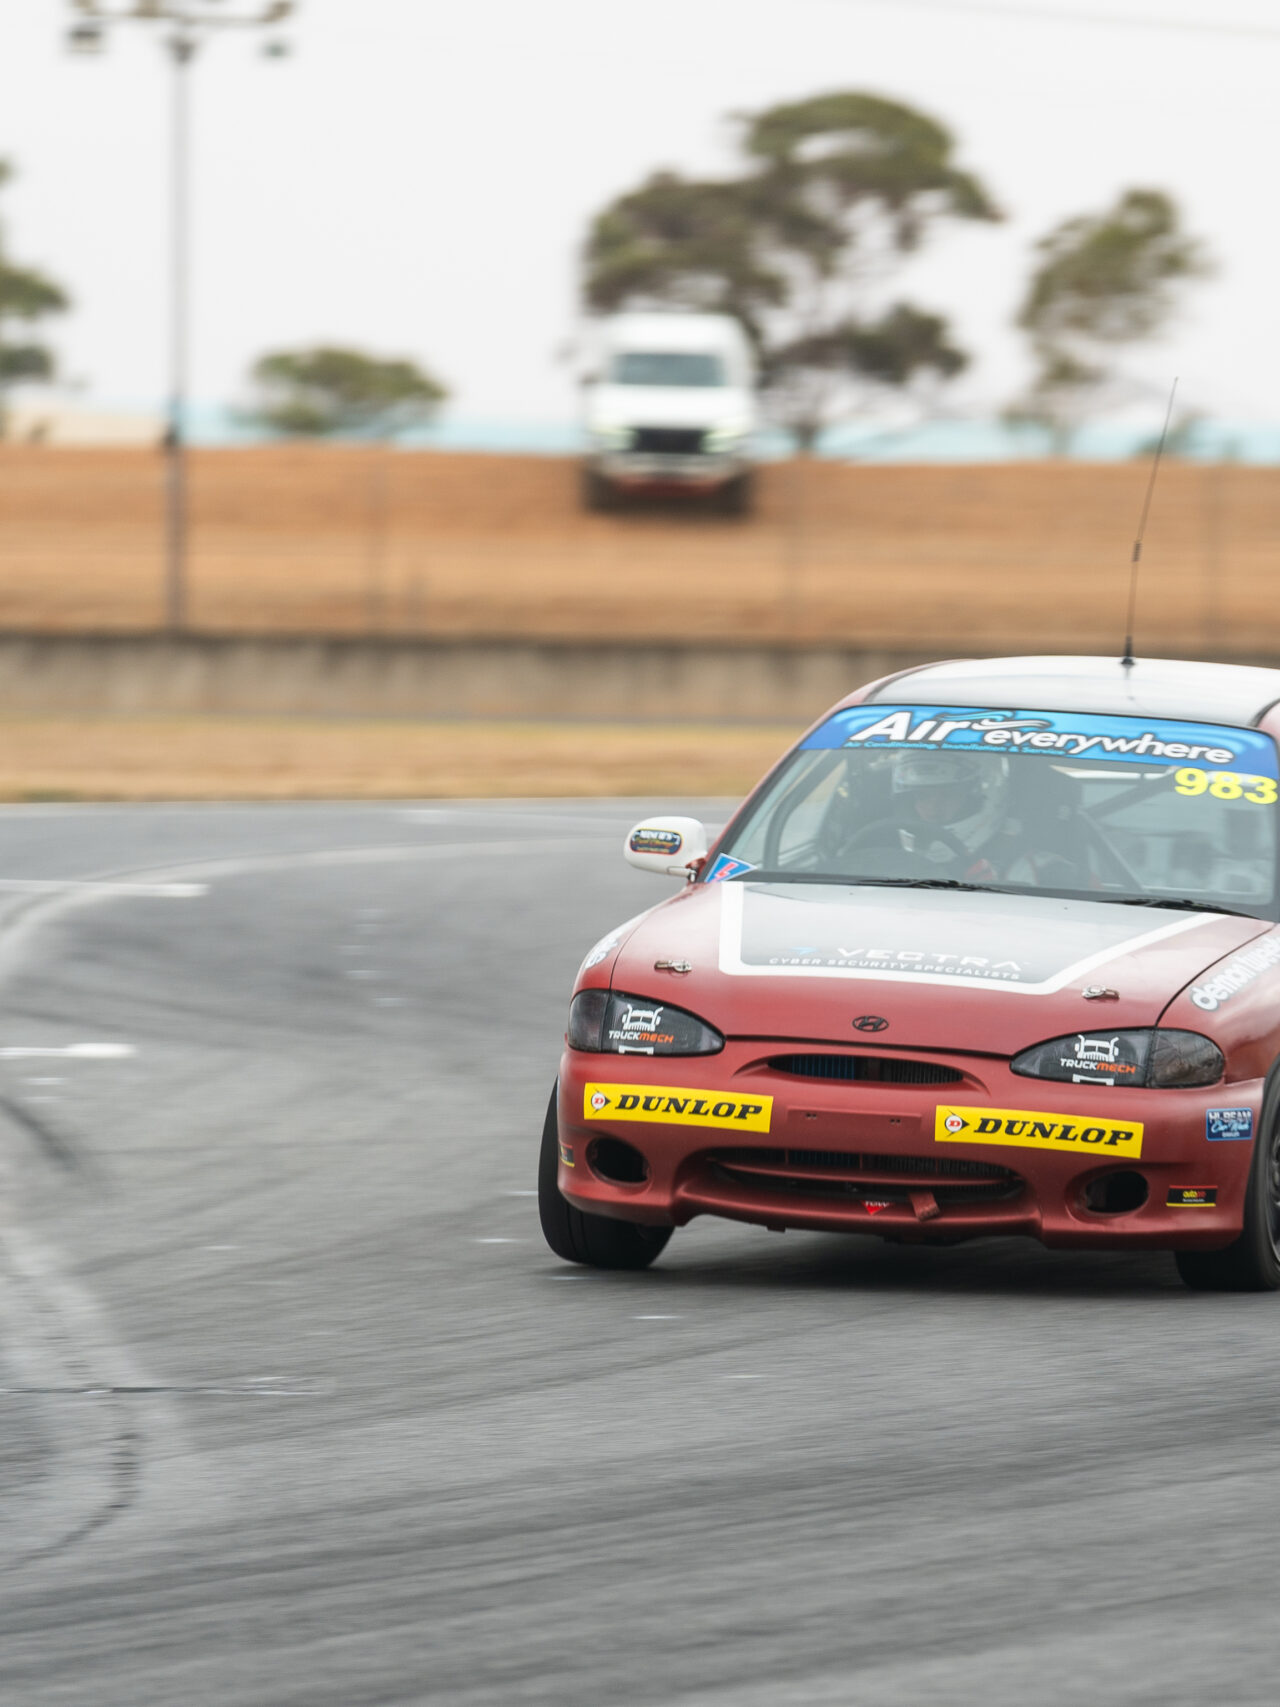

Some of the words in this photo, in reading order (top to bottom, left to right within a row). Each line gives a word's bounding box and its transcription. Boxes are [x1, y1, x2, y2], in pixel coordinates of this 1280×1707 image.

[849, 711, 971, 741] Air
[983, 729, 1235, 764] everywhere
[1174, 767, 1278, 805] 983
[768, 957, 822, 966] CYBER
[827, 957, 909, 970] SECURITY
[913, 963, 1021, 981] SPECIALISTS
[837, 947, 1022, 971] VECTRA
[608, 1029, 675, 1044] TRUCKMECH
[1060, 1057, 1137, 1075] TRUCKMECH
[615, 1094, 763, 1120] DUNLOP
[974, 1117, 1134, 1146] DUNLOP
